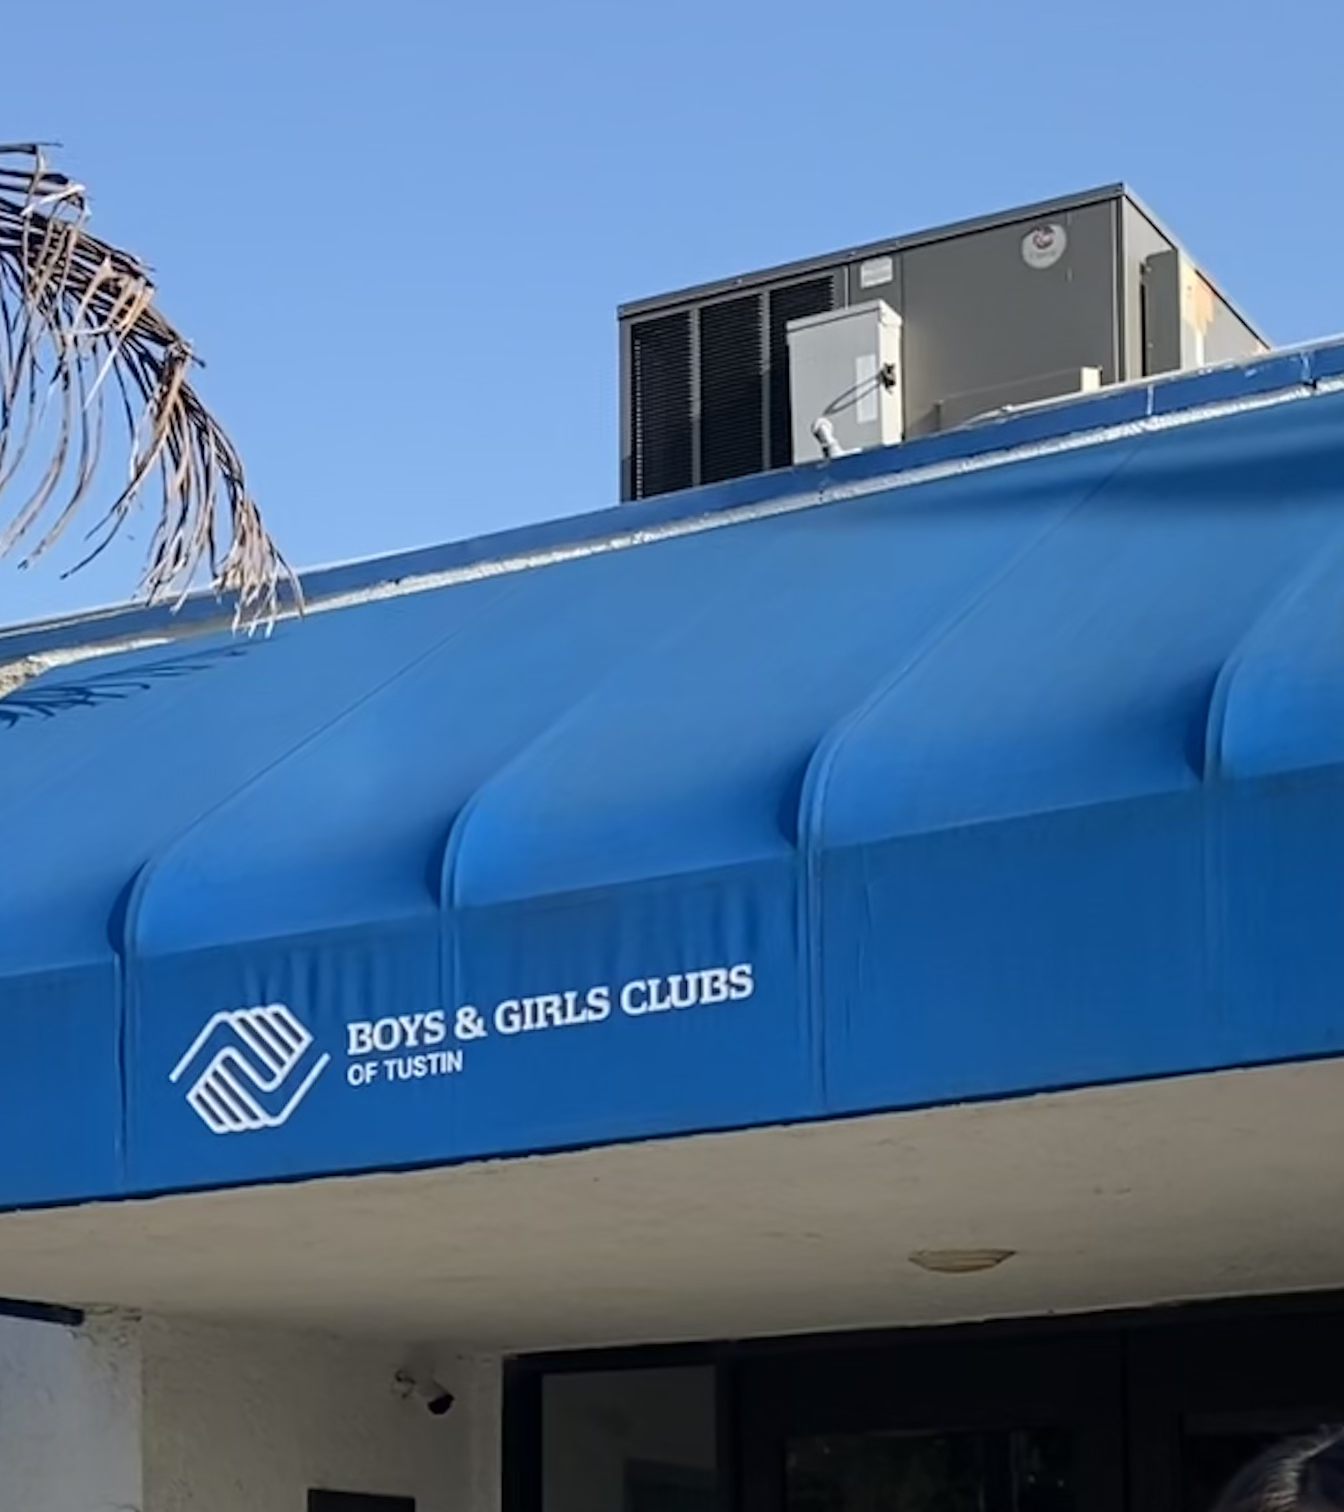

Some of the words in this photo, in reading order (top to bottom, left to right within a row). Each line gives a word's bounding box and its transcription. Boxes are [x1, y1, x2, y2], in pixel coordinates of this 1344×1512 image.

[347, 1010, 445, 1056] BOYS
[454, 1004, 486, 1041] &
[494, 985, 611, 1034] GIRLS
[621, 963, 754, 1015] CLUBS
[347, 1062, 378, 1086] OF
[384, 1049, 464, 1082] TUSTIN
